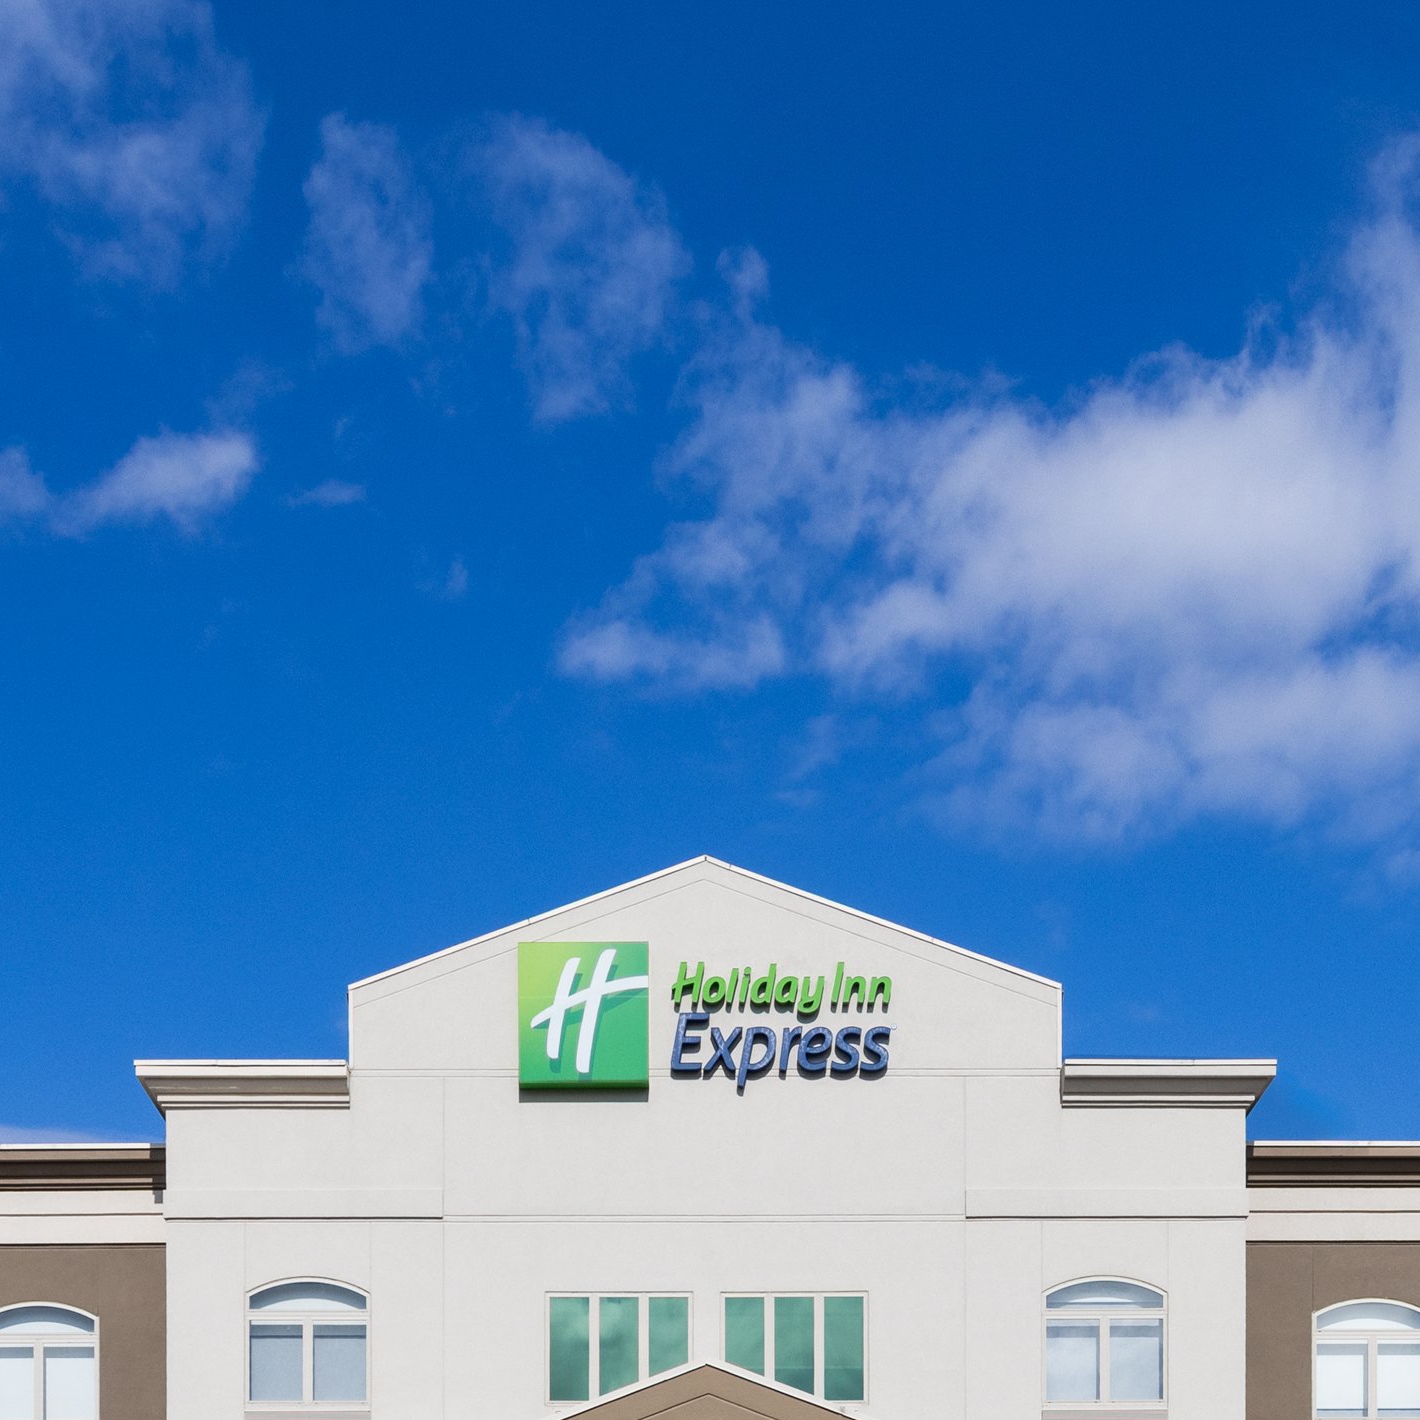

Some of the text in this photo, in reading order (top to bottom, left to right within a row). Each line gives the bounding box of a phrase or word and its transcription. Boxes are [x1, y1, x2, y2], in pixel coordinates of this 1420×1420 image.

[530, 948, 648, 1074] H
[671, 961, 893, 1014] Holiday Inn
[670, 1012, 892, 1090] Express
